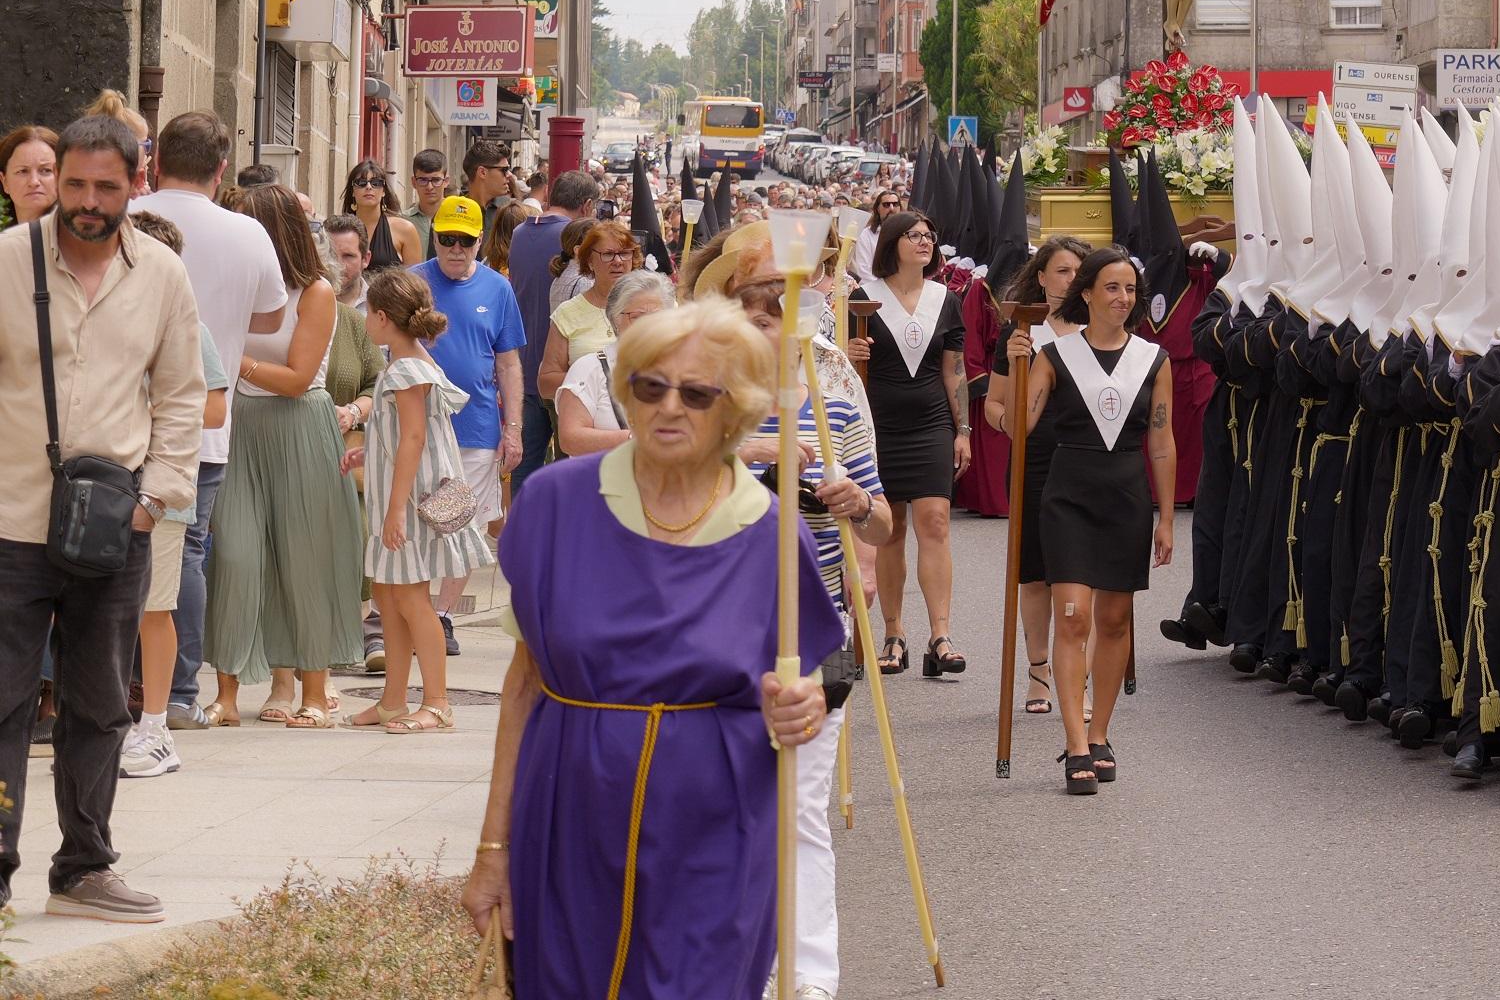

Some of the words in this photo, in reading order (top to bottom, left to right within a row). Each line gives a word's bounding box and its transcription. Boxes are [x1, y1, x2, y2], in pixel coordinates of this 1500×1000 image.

[451, 38, 520, 54] ANTONIO
[426, 55, 504, 72] JOYERÍAS
[1374, 72, 1415, 81] OURENSE
[1453, 74, 1493, 83] Farmacia
[1336, 102, 1357, 110] VIGO
